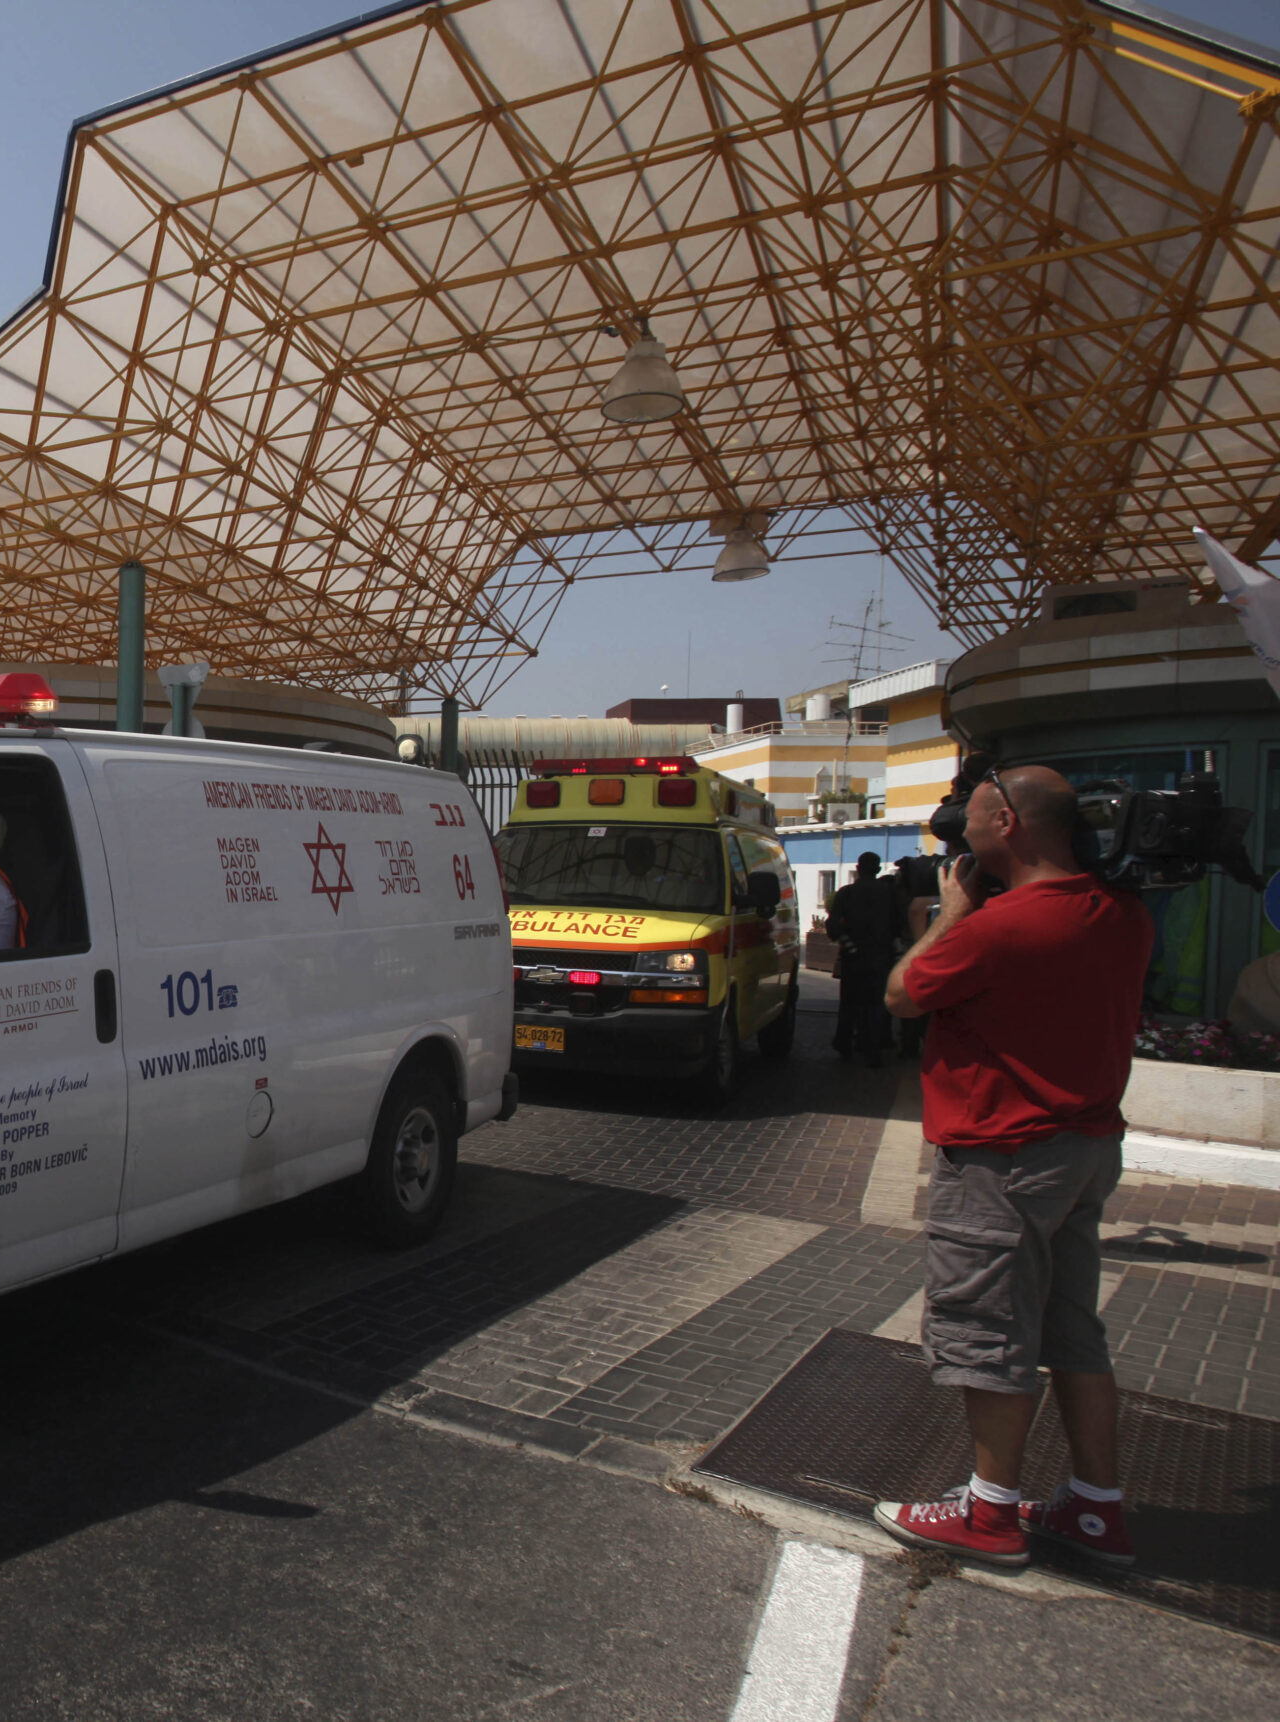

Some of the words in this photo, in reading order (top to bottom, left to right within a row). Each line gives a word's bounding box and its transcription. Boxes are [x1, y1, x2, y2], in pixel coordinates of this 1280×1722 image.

[202, 781, 254, 808] AMERICAN
[251, 783, 293, 810] FRIENDS
[290, 784, 305, 811] OF
[303, 785, 337, 812] MAGEN
[332, 787, 358, 813] DAVID
[429, 803, 466, 827] נגב
[217, 837, 260, 852] MAGEN
[374, 841, 394, 857] דוד
[397, 841, 414, 858] מגן
[220, 854, 256, 869] DAVID
[389, 859, 416, 876] אדום
[226, 871, 261, 886] ADOM
[379, 875, 421, 895] בישראל
[453, 854, 475, 900] 64
[226, 887, 238, 903] IN
[241, 886, 279, 903] ISRAEL
[550, 911, 592, 920] דוד
[604, 914, 646, 925] מגן
[454, 923, 500, 940] SAVANA
[510, 921, 641, 938] BULANCE
[18, 979, 62, 998] FRIENDS
[65, 977, 78, 991] OF
[160, 969, 214, 1018] 101
[6, 1000, 41, 1017] DAVID
[44, 995, 75, 1011] ADOM
[3, 1022, 38, 1035] ARMDI
[139, 1035, 267, 1080] www.mdais.org
[8, 1081, 43, 1109] people
[45, 1078, 57, 1102] of
[57, 1072, 89, 1093] Israel
[3, 1122, 50, 1145] POPPER
[0, 1150, 14, 1162] By
[10, 1158, 42, 1179] BORN
